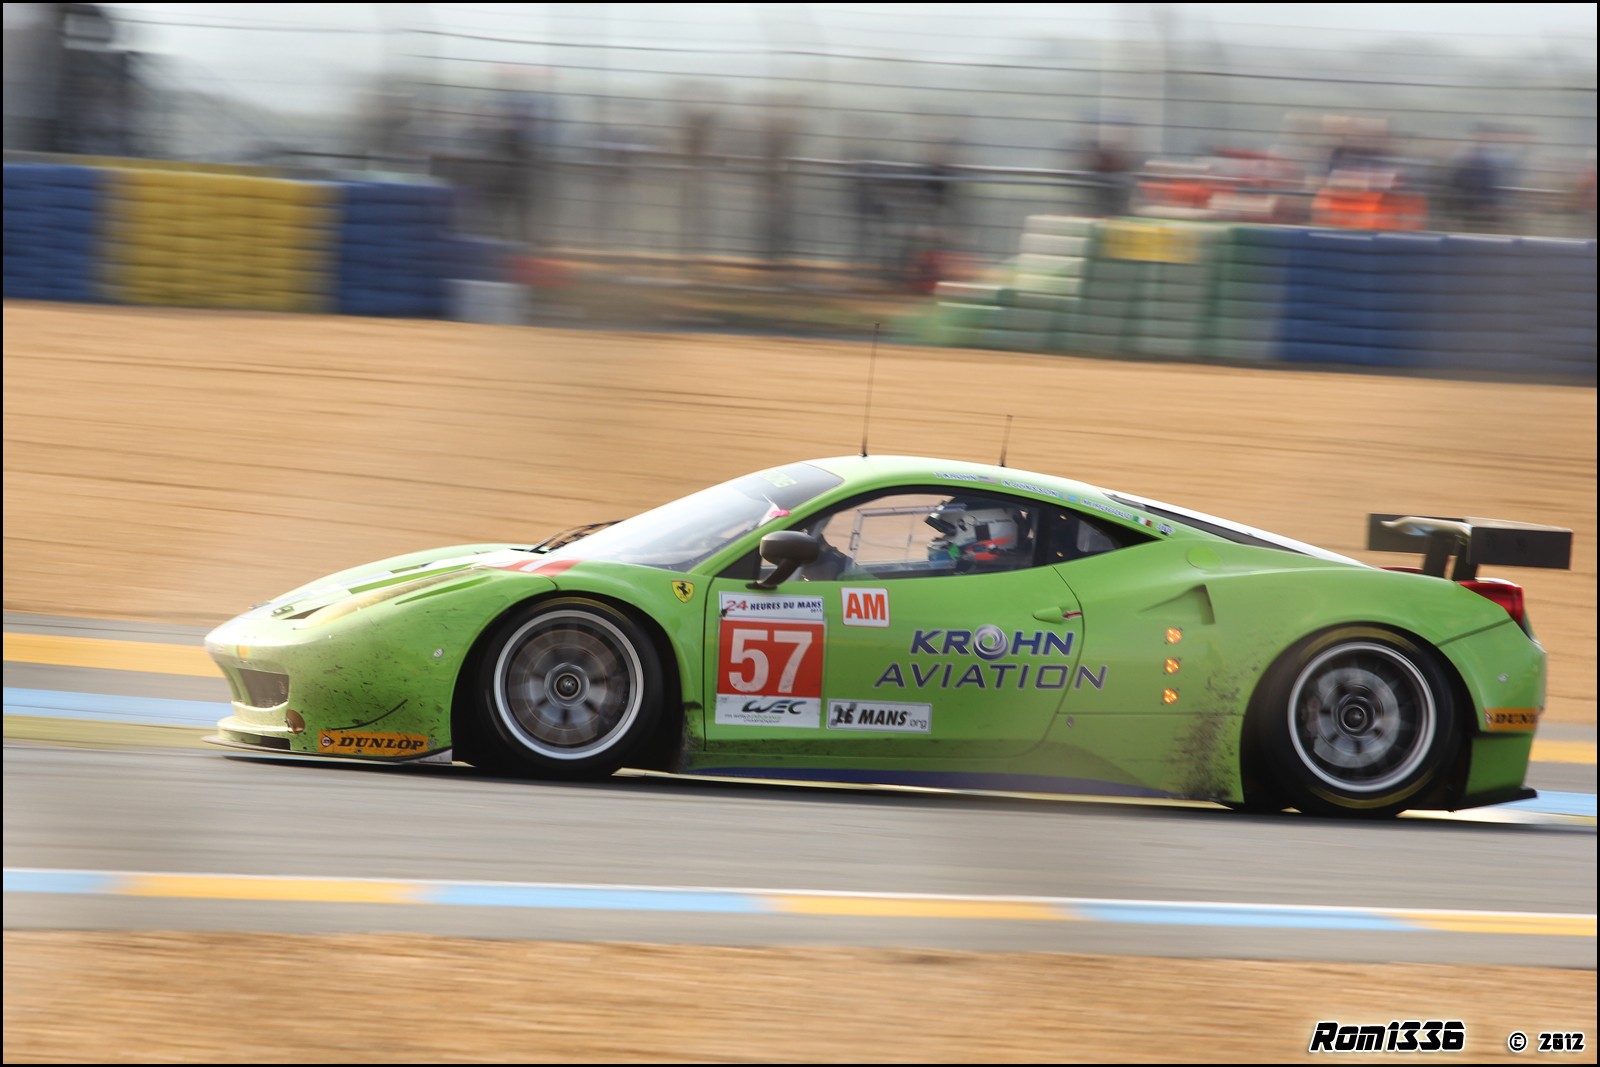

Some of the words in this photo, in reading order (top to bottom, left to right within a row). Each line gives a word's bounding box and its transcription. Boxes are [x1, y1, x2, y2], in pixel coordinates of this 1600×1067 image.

[726, 600, 749, 612] 24
[750, 602, 780, 611] HEURES
[783, 601, 795, 610] DU
[797, 601, 822, 609] MANS
[845, 593, 887, 621] AM
[909, 624, 1075, 661] KROHN
[728, 628, 813, 694] 57
[873, 663, 1108, 690] AVIATION
[742, 700, 807, 714] WEC
[858, 709, 908, 726] MANS
[338, 737, 424, 751] DUNLOP
